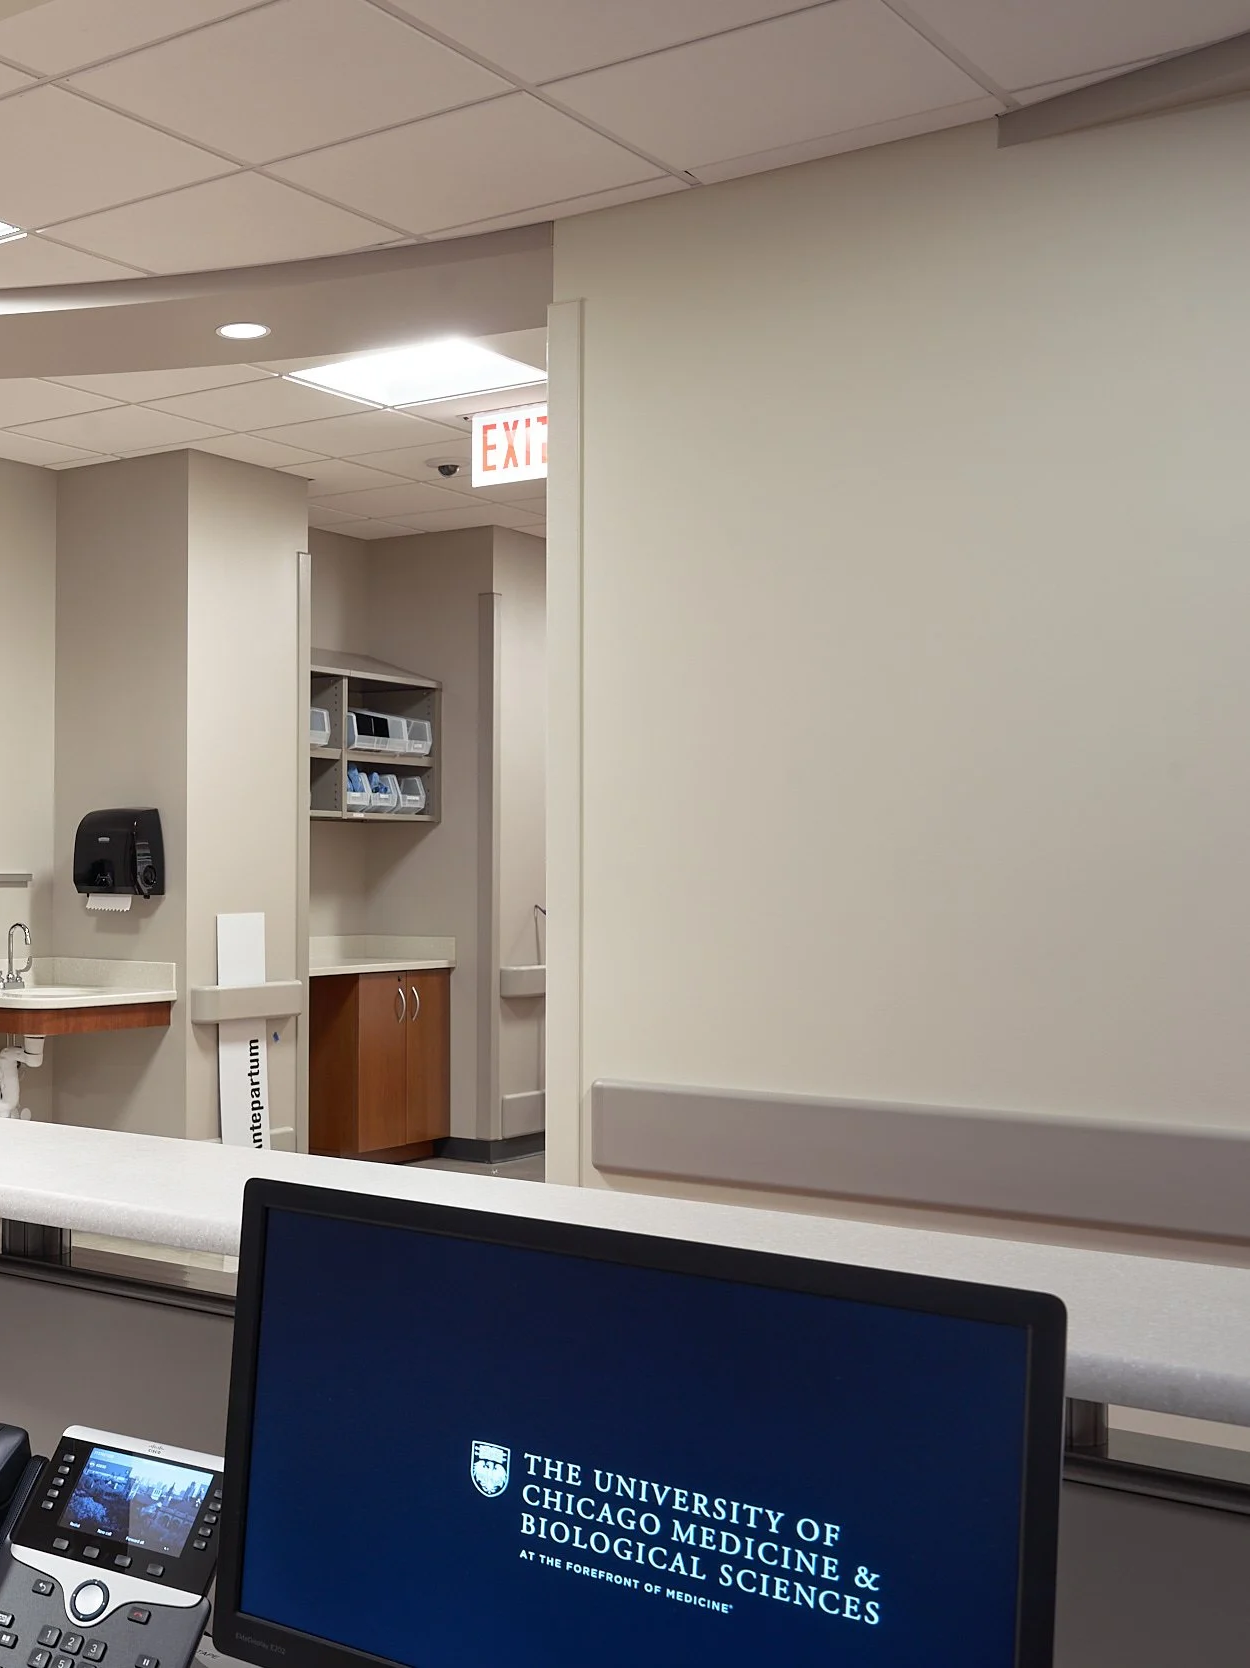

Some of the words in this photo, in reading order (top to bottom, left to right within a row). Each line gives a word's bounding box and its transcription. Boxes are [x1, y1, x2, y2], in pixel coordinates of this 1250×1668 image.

[482, 415, 548, 472] EXIT
[522, 1452, 582, 1486] THE
[593, 1469, 785, 1534] UNIVERSITY
[796, 1518, 841, 1547] OF
[521, 1484, 662, 1535] CHICAGO
[670, 1519, 840, 1582] MEDICINE
[854, 1565, 881, 1592] &
[519, 1549, 536, 1560] AT
[539, 1554, 562, 1569] THE
[566, 1561, 640, 1590] FOREFRONT
[644, 1581, 662, 1595] OF
[520, 1513, 707, 1580] BIOLOGICAL
[718, 1564, 881, 1625] SCIENCES
[35, 1653, 42, 1662] 4
[57, 1659, 65, 1668] 5
[68, 1637, 75, 1646] 2
[90, 1644, 97, 1653] 3
